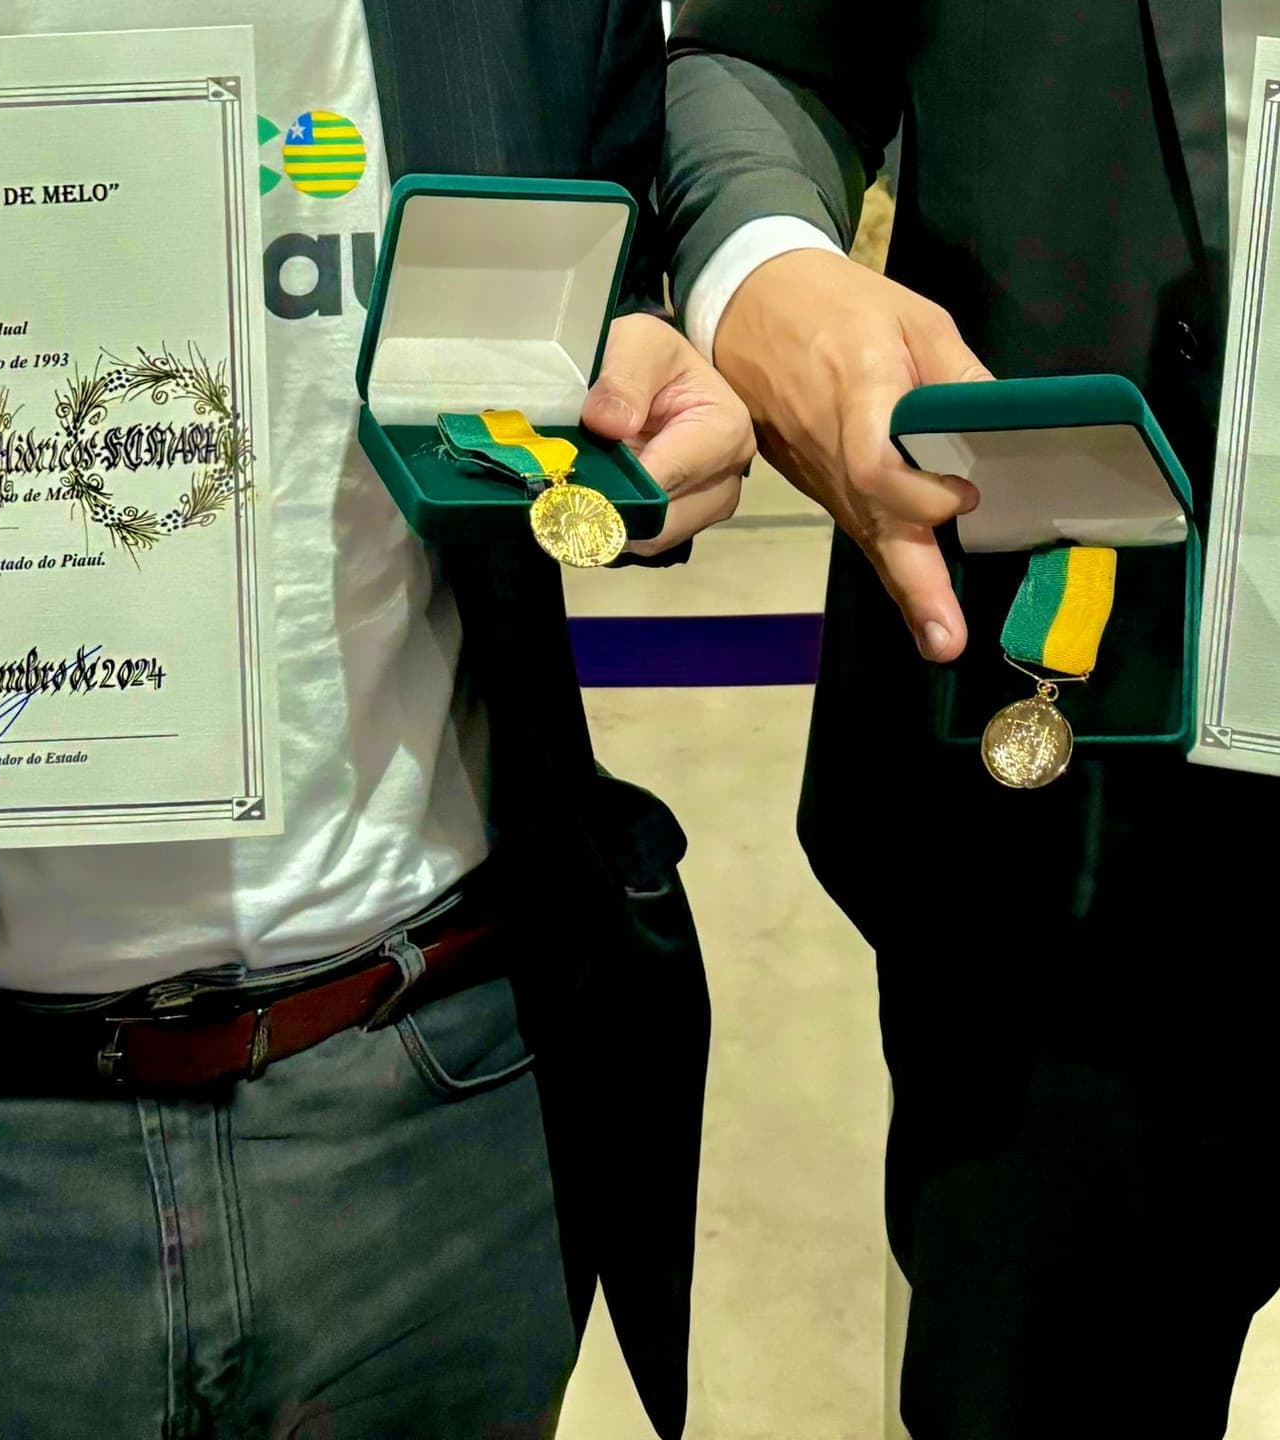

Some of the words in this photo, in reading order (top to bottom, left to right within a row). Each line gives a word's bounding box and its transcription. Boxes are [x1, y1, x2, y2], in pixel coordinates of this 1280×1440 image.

[3, 185, 36, 206] DE
[41, 182, 119, 204] MELO”
[37, 554, 56, 569] do
[60, 551, 106, 568] Piauí.
[70, 645, 100, 696] de
[98, 657, 167, 691] 2024
[25, 752, 42, 765] do
[44, 750, 88, 764] Estado
